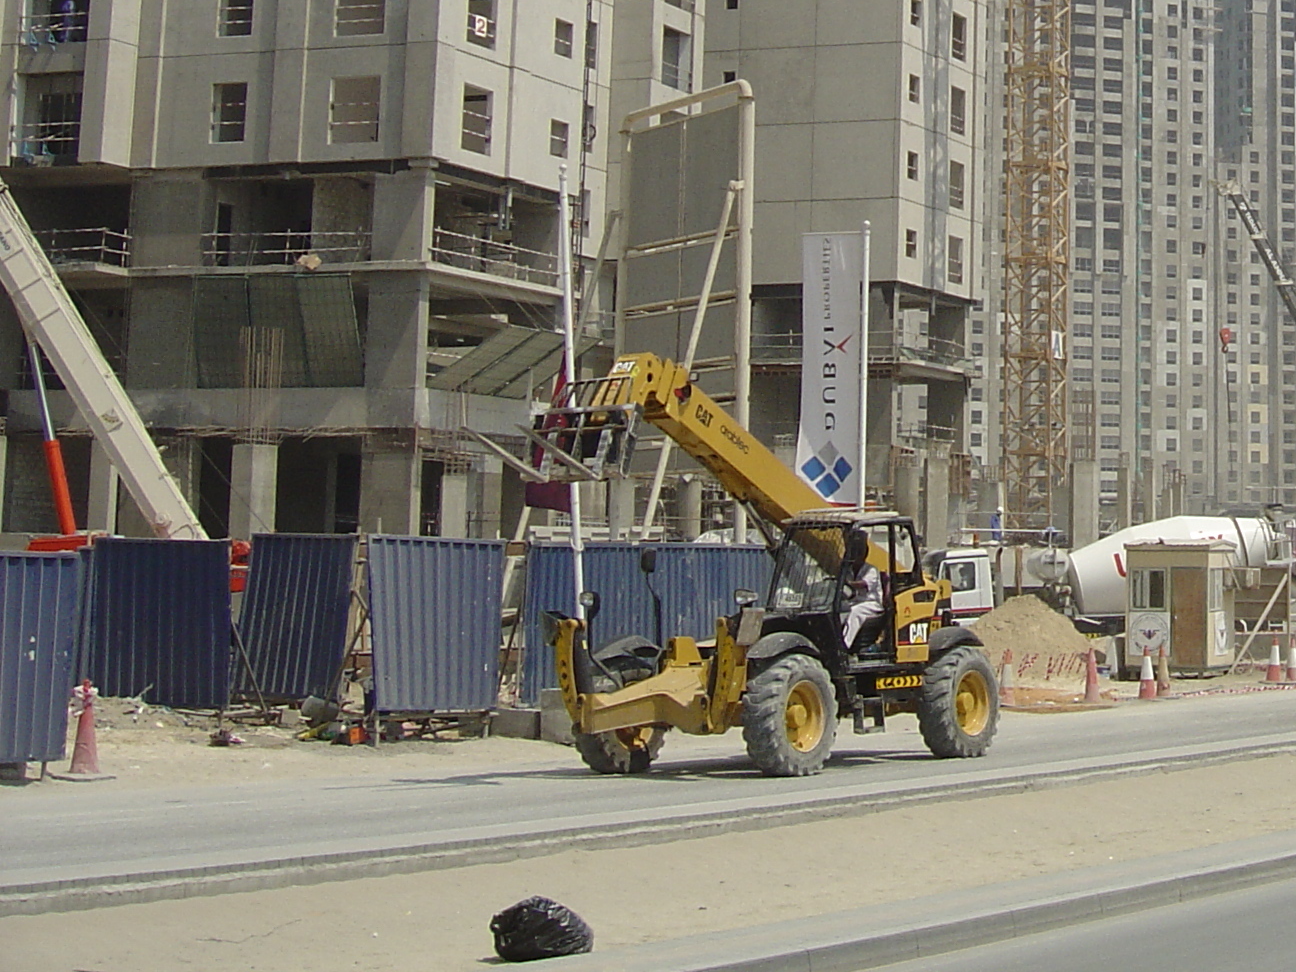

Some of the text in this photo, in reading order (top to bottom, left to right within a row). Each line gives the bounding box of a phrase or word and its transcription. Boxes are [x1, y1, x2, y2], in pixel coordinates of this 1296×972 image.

[476, 18, 485, 34] 2
[613, 361, 635, 373] CAT
[695, 404, 714, 428] CAT
[909, 623, 929, 644] CAT
